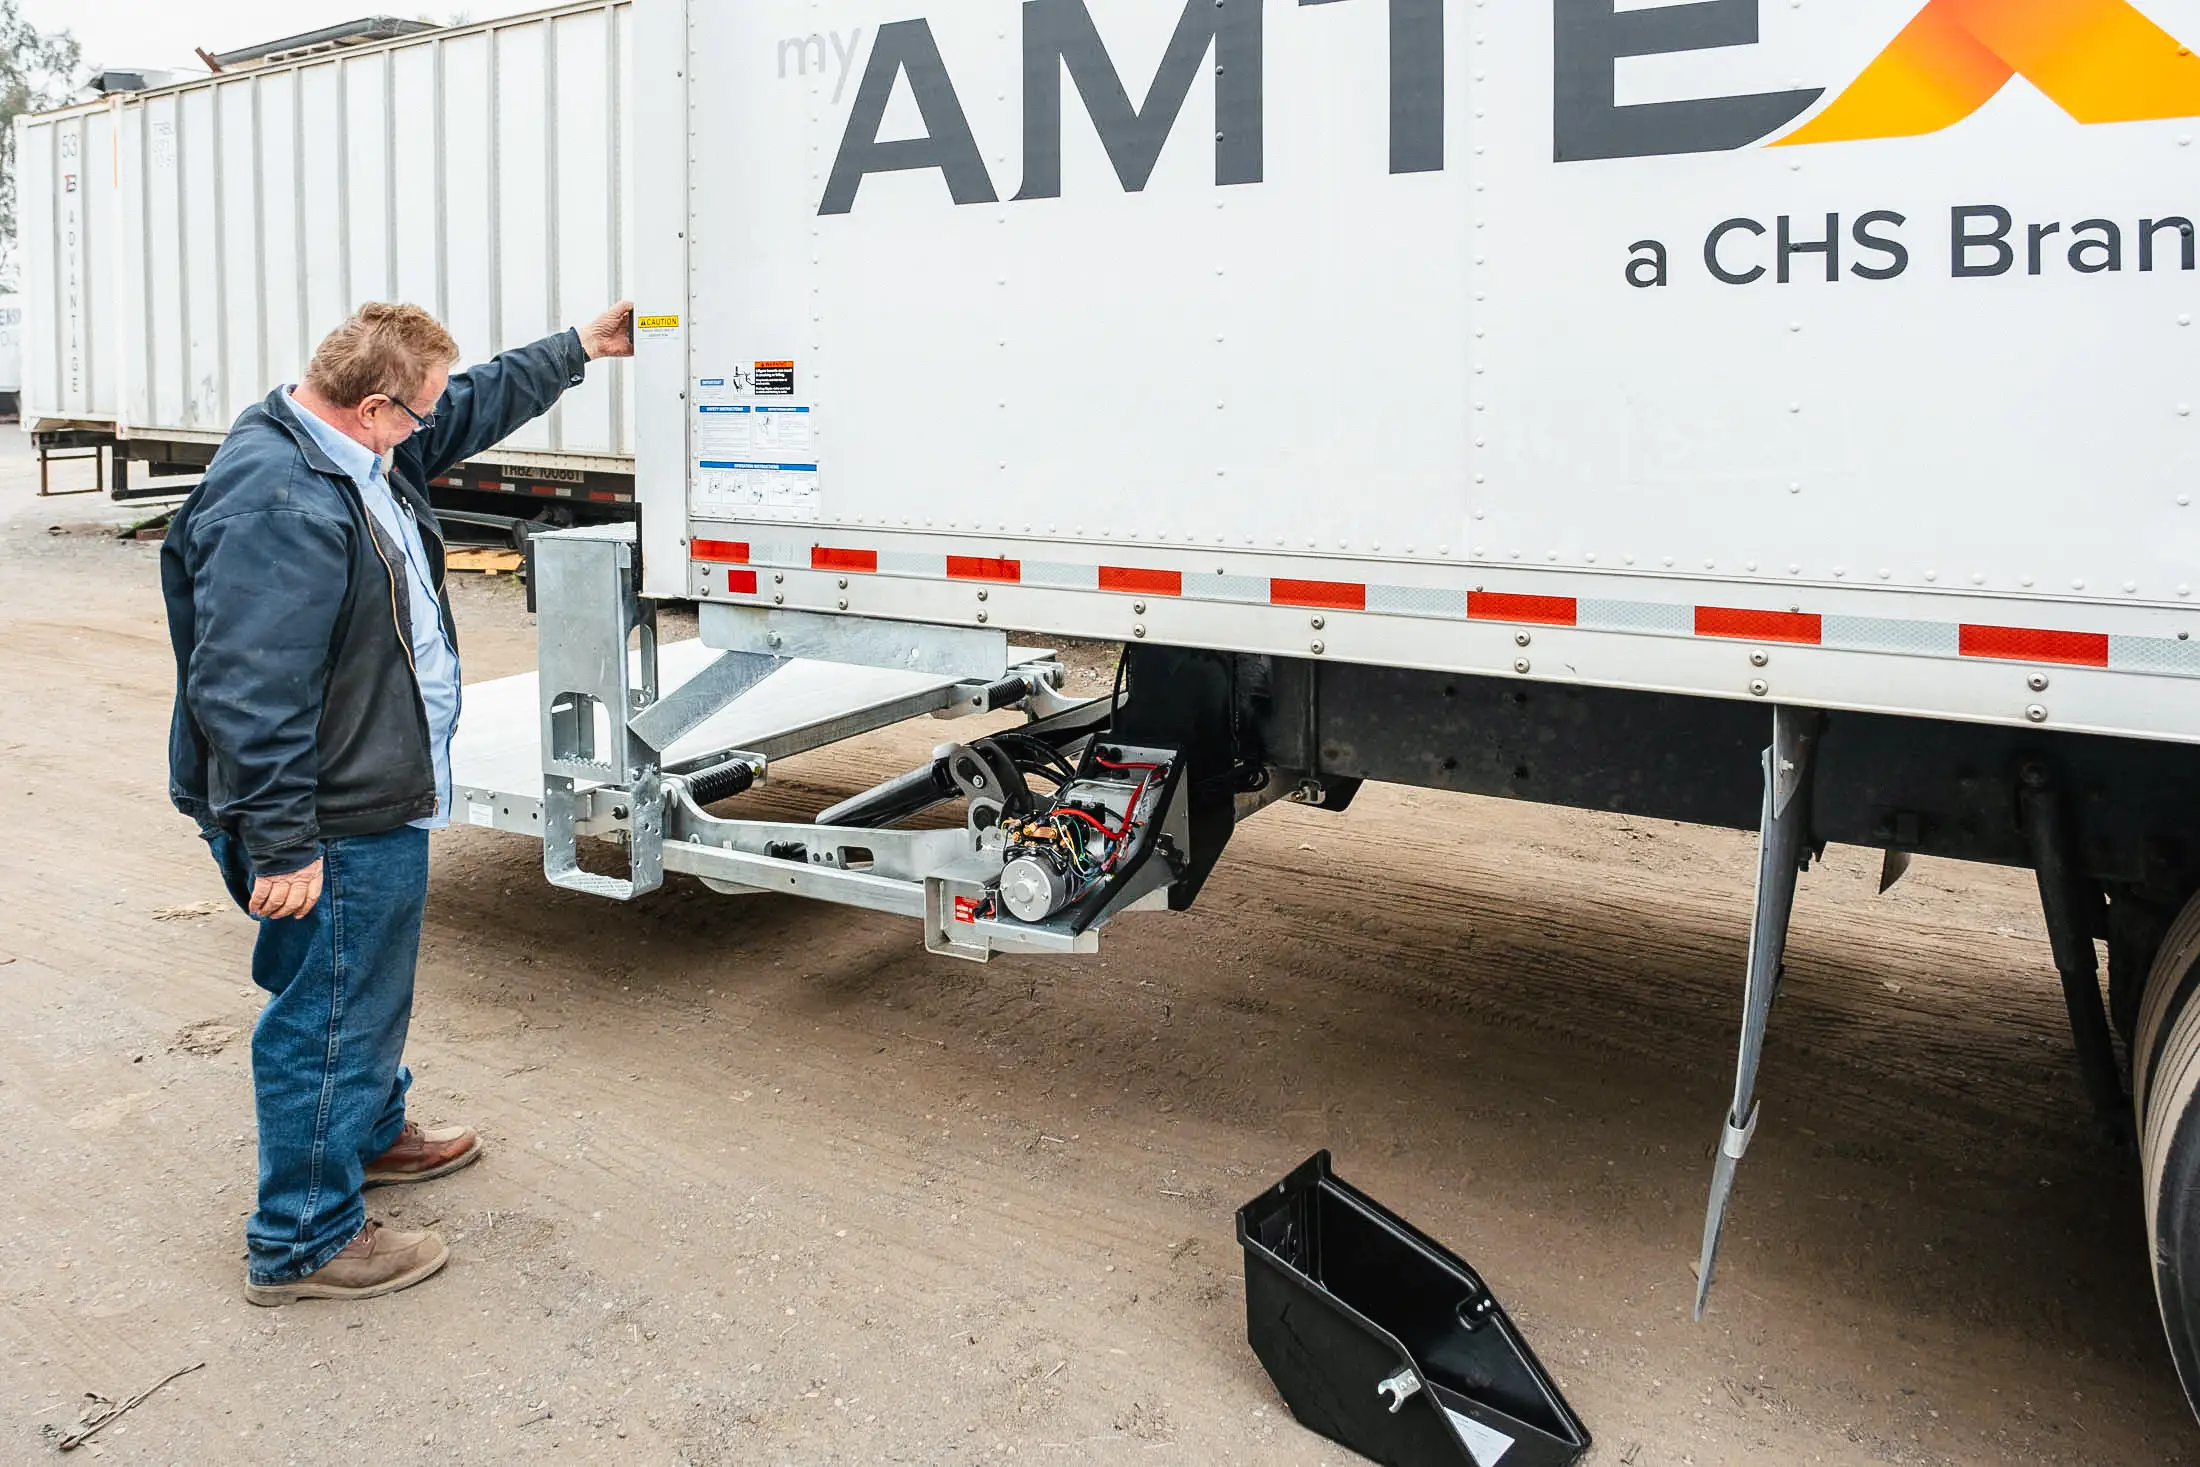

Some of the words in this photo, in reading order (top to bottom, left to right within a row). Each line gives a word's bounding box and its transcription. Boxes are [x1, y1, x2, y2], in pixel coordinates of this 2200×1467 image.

[777, 27, 861, 105] my
[1624, 239, 1667, 288] a
[1703, 209, 1909, 284] CHS
[1951, 204, 2195, 278] Bran
[67, 209, 79, 394] ADVANTAGE
[646, 318, 677, 326] CAUTION
